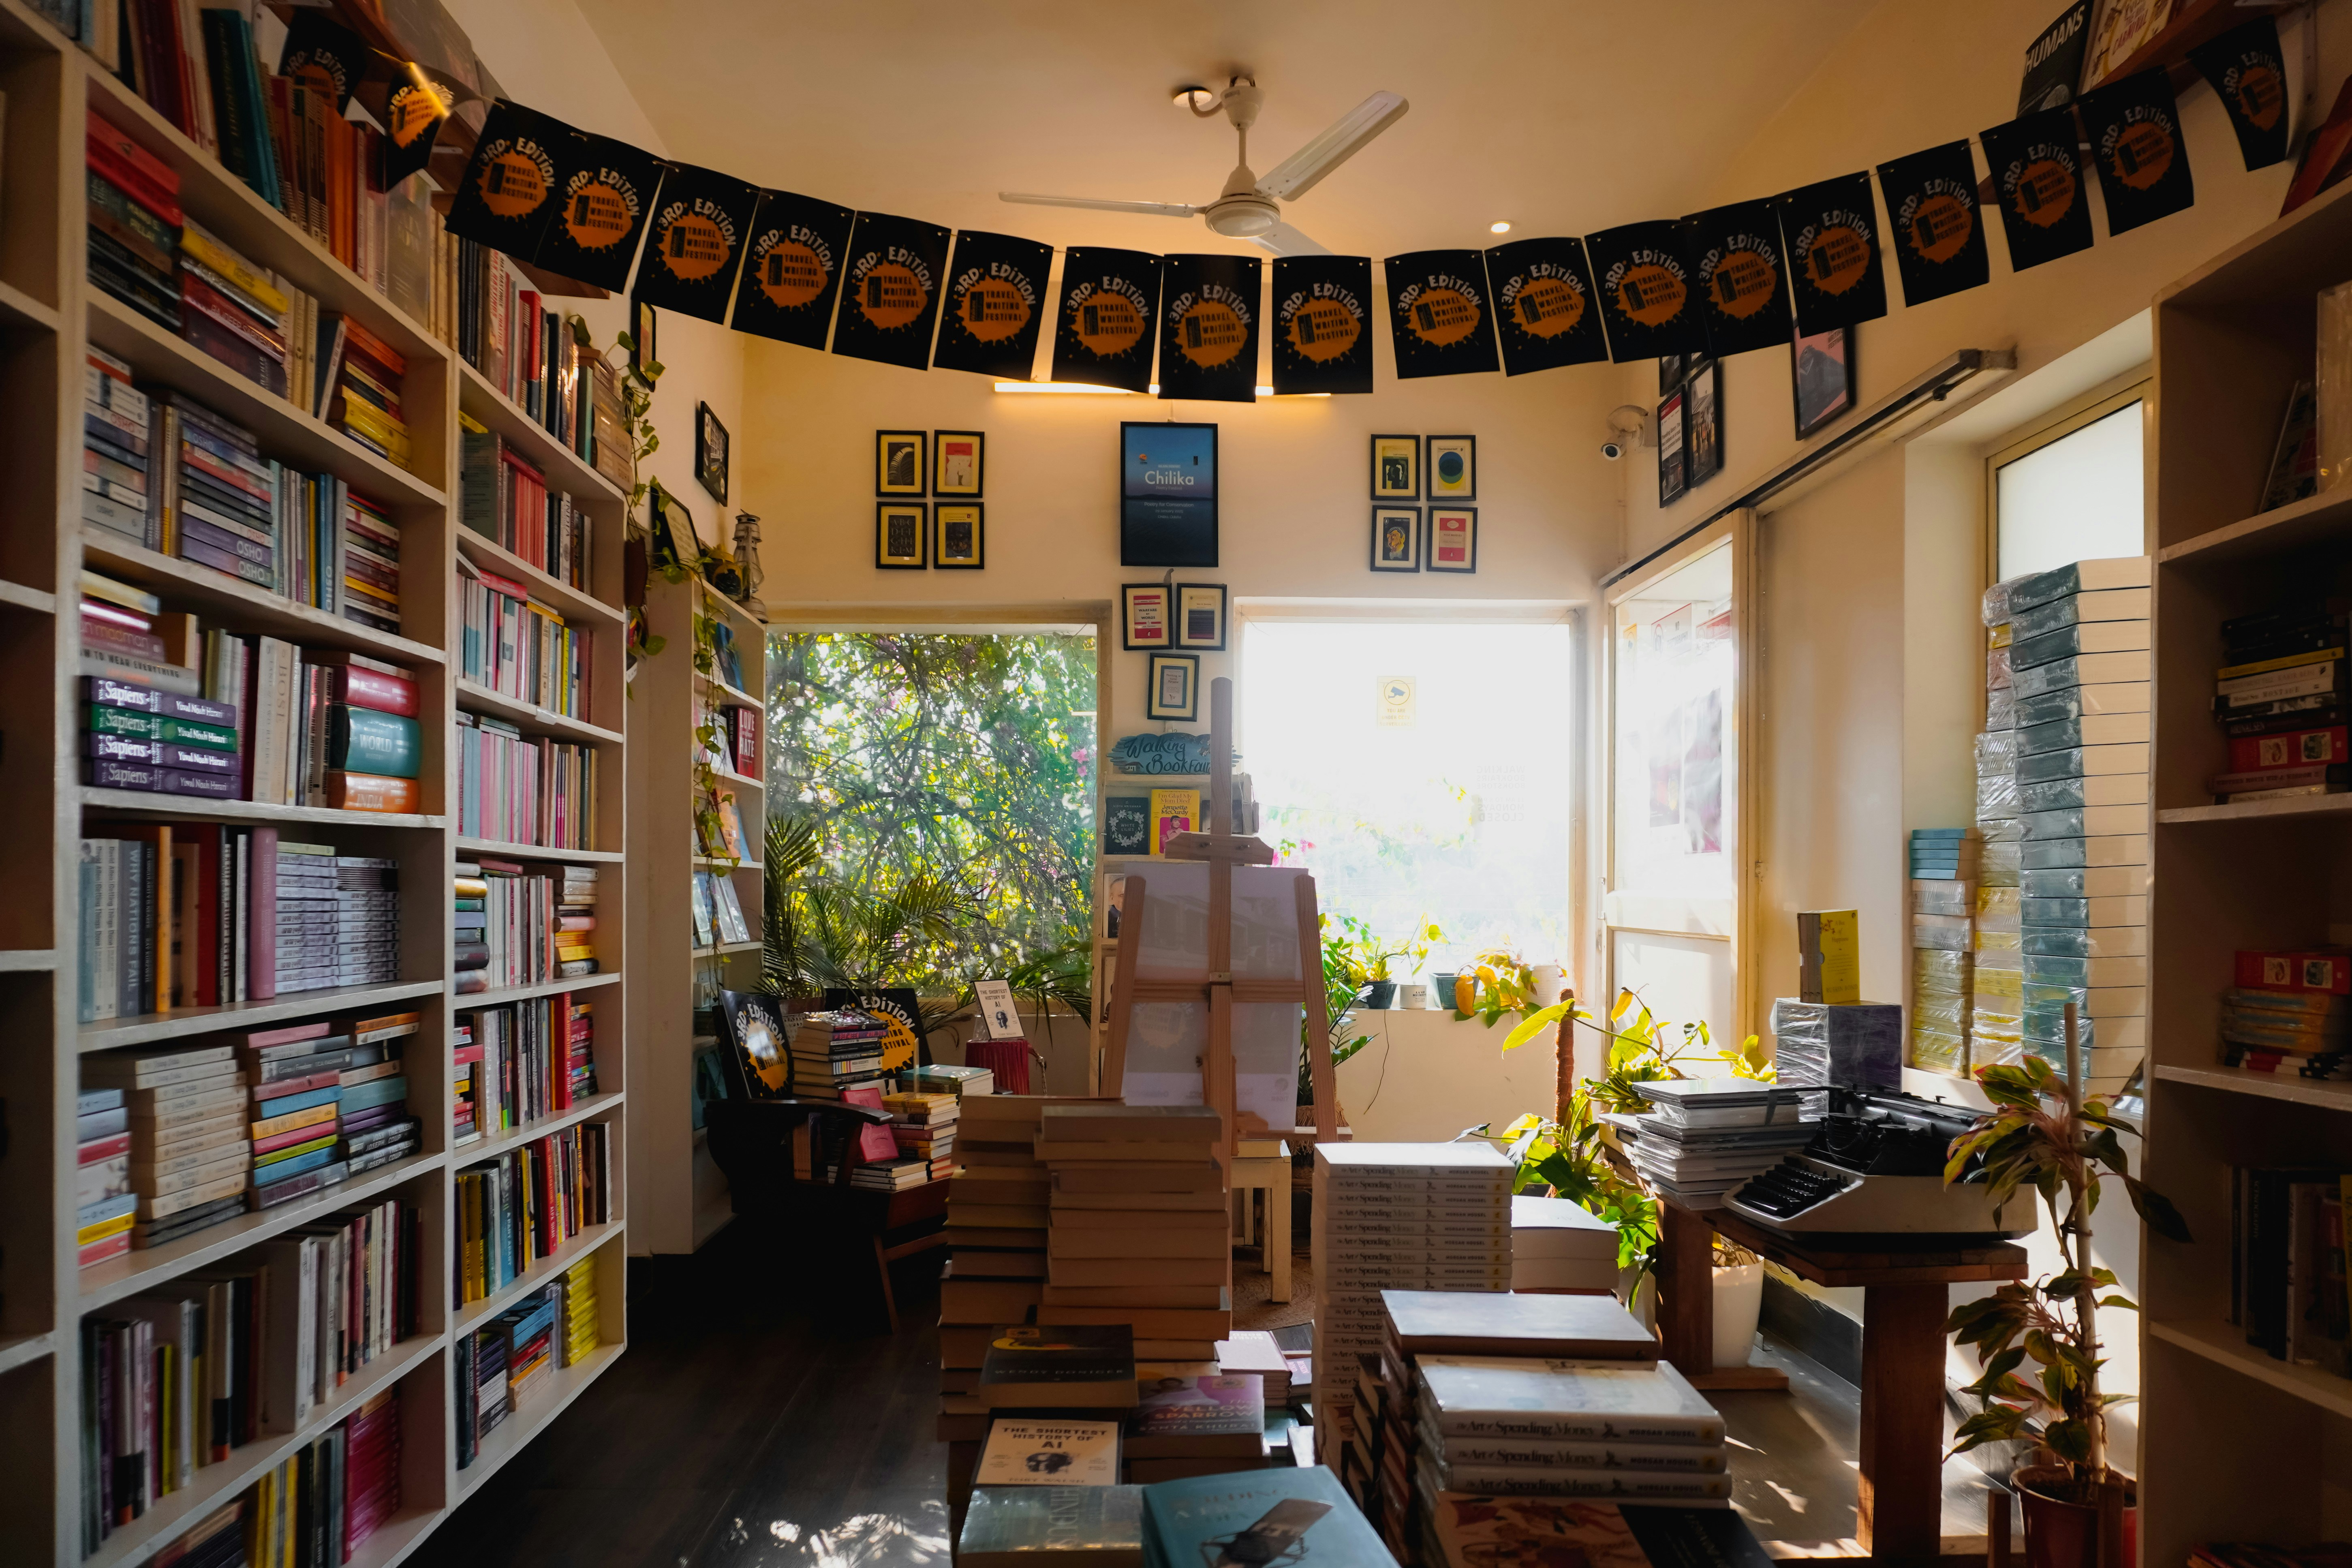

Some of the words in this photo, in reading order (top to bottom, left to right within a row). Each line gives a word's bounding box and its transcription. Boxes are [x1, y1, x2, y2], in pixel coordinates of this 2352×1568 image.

[2022, 4, 2086, 78] HUMANS
[592, 195, 619, 207] TRAVEL
[590, 207, 622, 219] WRITING
[588, 218, 623, 232] FESTIVAL
[785, 254, 813, 264] TRAVEL
[1730, 258, 1758, 274] TRAVEL
[784, 266, 817, 276] WRITING
[1734, 268, 1766, 285] WRITING
[784, 278, 819, 288] FESTIVAL
[1738, 279, 1772, 297] FESTIVAL
[986, 291, 1014, 299] TRAVEL
[1535, 285, 1564, 299] TRAVEL
[1538, 294, 1572, 308] WRITING
[1313, 309, 1342, 319] TRAVEL
[1542, 303, 1579, 318] FESTIVAL
[1315, 319, 1349, 329] WRITING
[1317, 329, 1353, 341] FESTIVAL
[1145, 470, 1194, 485] Chilika
[237, 541, 263, 560] OSHO
[239, 560, 265, 581] OSHO
[94, 651, 104, 661] TO
[109, 655, 129, 667] WEAR
[133, 660, 180, 678] EVERYTHING
[105, 681, 147, 706] Sapiens
[176, 701, 190, 711] Yuval
[188, 702, 202, 714] Noah
[202, 706, 224, 718] Harari
[105, 709, 148, 733] Sapiens
[177, 727, 190, 736] Yuval
[190, 728, 203, 740] Noah
[203, 731, 228, 743] Harari
[740, 708, 755, 731] LOVE
[360, 734, 390, 752] WORLD
[740, 736, 755, 757] HATE
[1125, 735, 1186, 761] Walking
[105, 735, 149, 760] Sapiens
[178, 751, 192, 762] Yuval
[190, 753, 203, 764] Noah
[203, 755, 229, 767] Harari
[109, 763, 150, 786] Sapiens
[180, 777, 195, 787] Yuval
[196, 778, 210, 789] Noah
[210, 781, 227, 791] Harari
[357, 794, 383, 809] INDIA
[129, 849, 139, 882] WHY
[129, 887, 139, 956] NATIONS
[128, 960, 138, 992] FAIL
[1844, 984, 1858, 992] BOND
[388, 1133, 402, 1143] COUP
[365, 1140, 385, 1152] JOSEPH
[366, 1158, 385, 1170] JOSEPH
[389, 1152, 402, 1162] COUP
[1467, 1421, 1486, 1432] Art
[1495, 1421, 1553, 1436] Spending
[1555, 1422, 1593, 1435] Money
